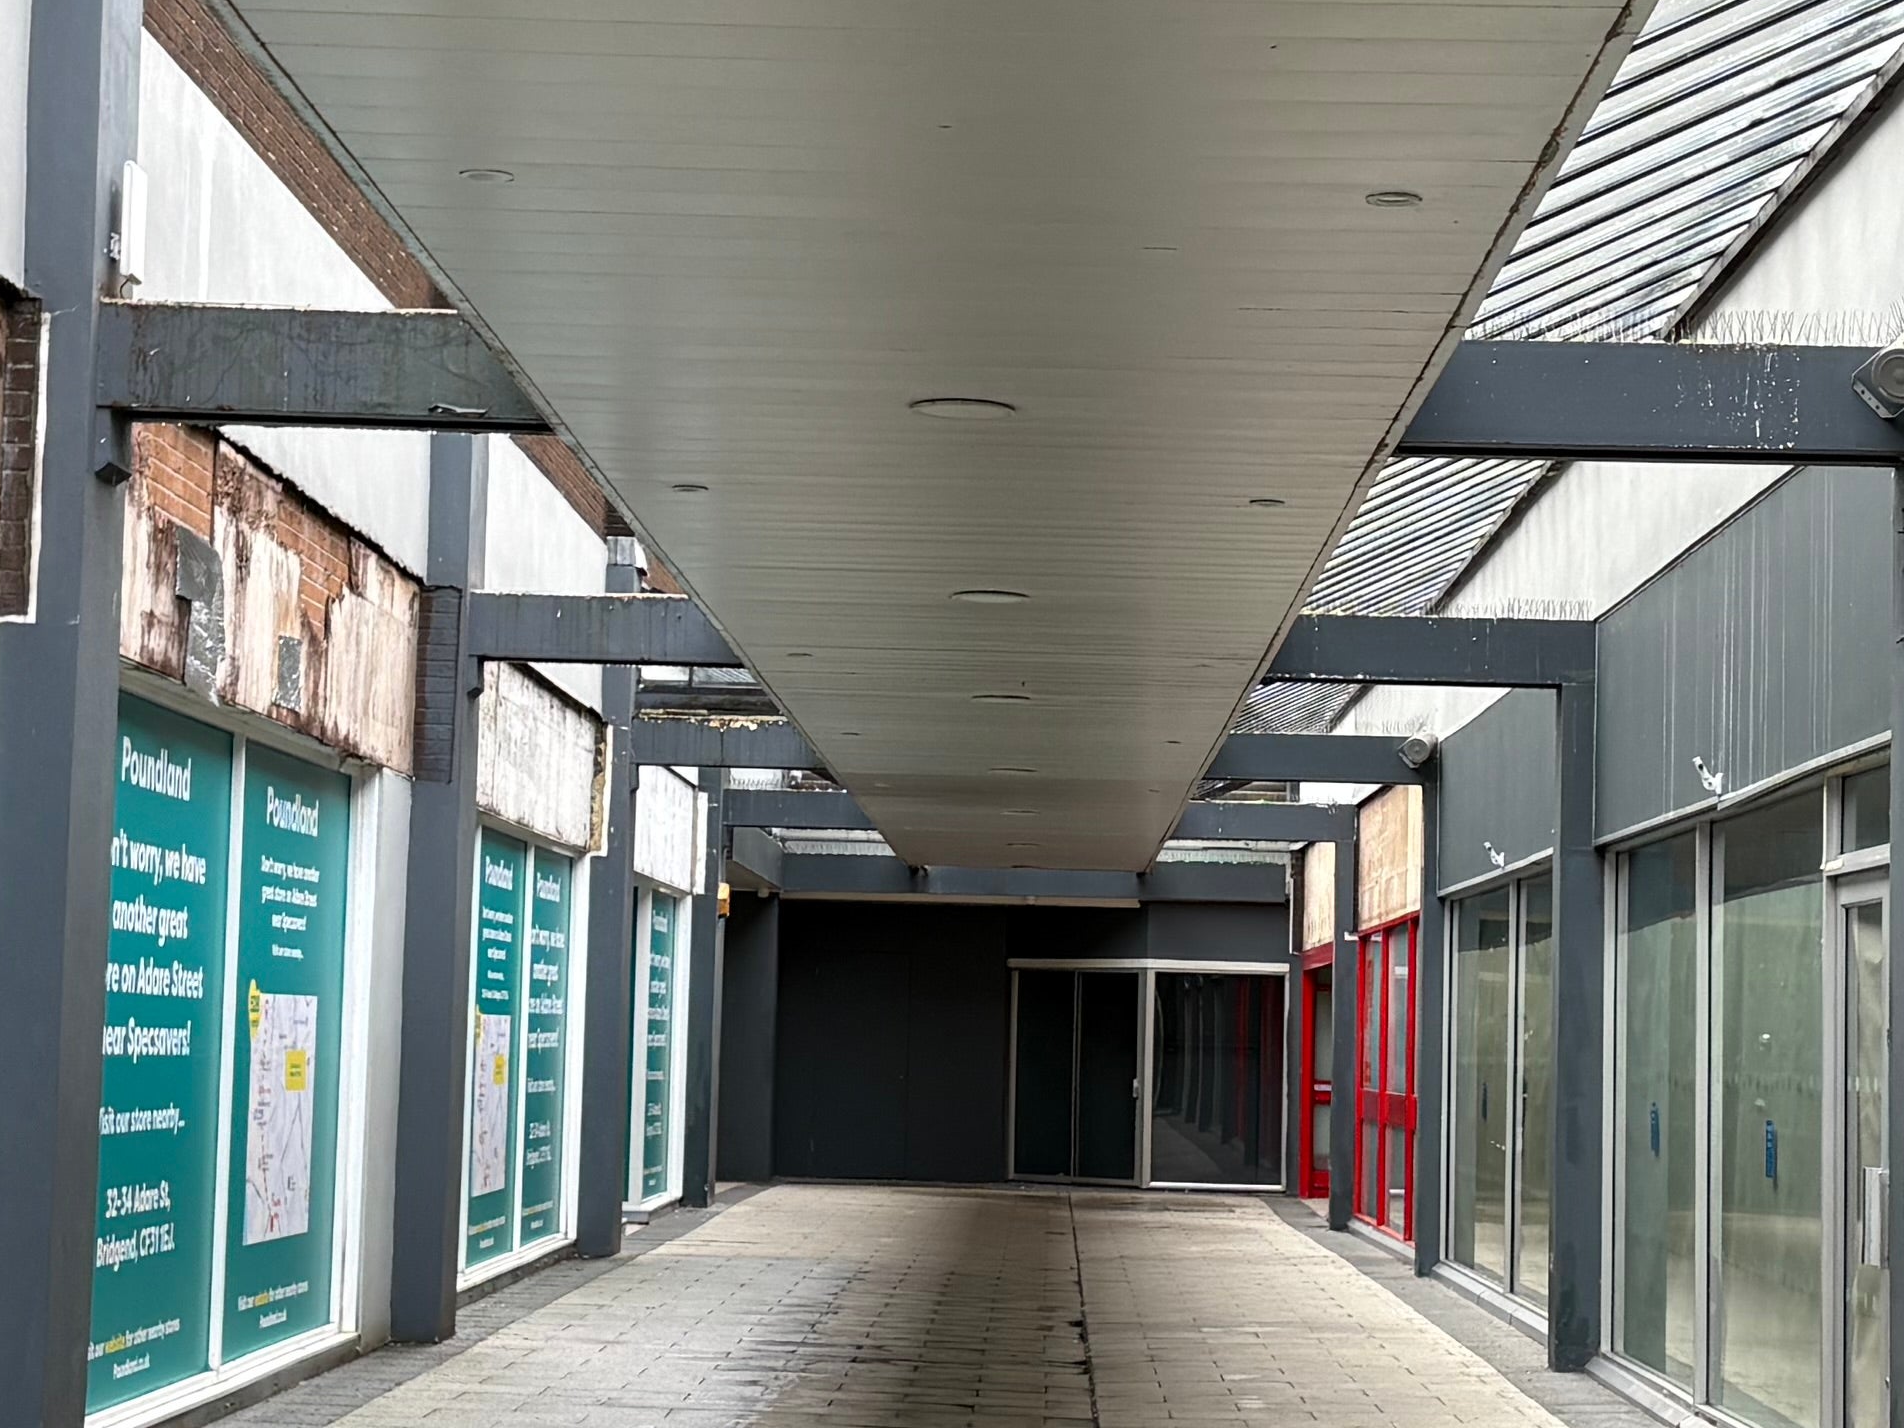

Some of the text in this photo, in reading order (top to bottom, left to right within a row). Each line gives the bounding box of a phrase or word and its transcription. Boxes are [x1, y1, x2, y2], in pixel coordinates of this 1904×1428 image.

[121, 736, 192, 801] Poundland
[266, 786, 319, 837] Poundland
[110, 828, 207, 886] n't worry, we have
[112, 893, 188, 947] another great
[121, 964, 137, 993] on
[136, 958, 171, 996] Adare
[171, 960, 204, 999] Street
[127, 1017, 191, 1062] Specsavers!
[105, 1186, 133, 1219] 32-34
[133, 1183, 160, 1213] Adare
[96, 1230, 139, 1272] Bridgend,
